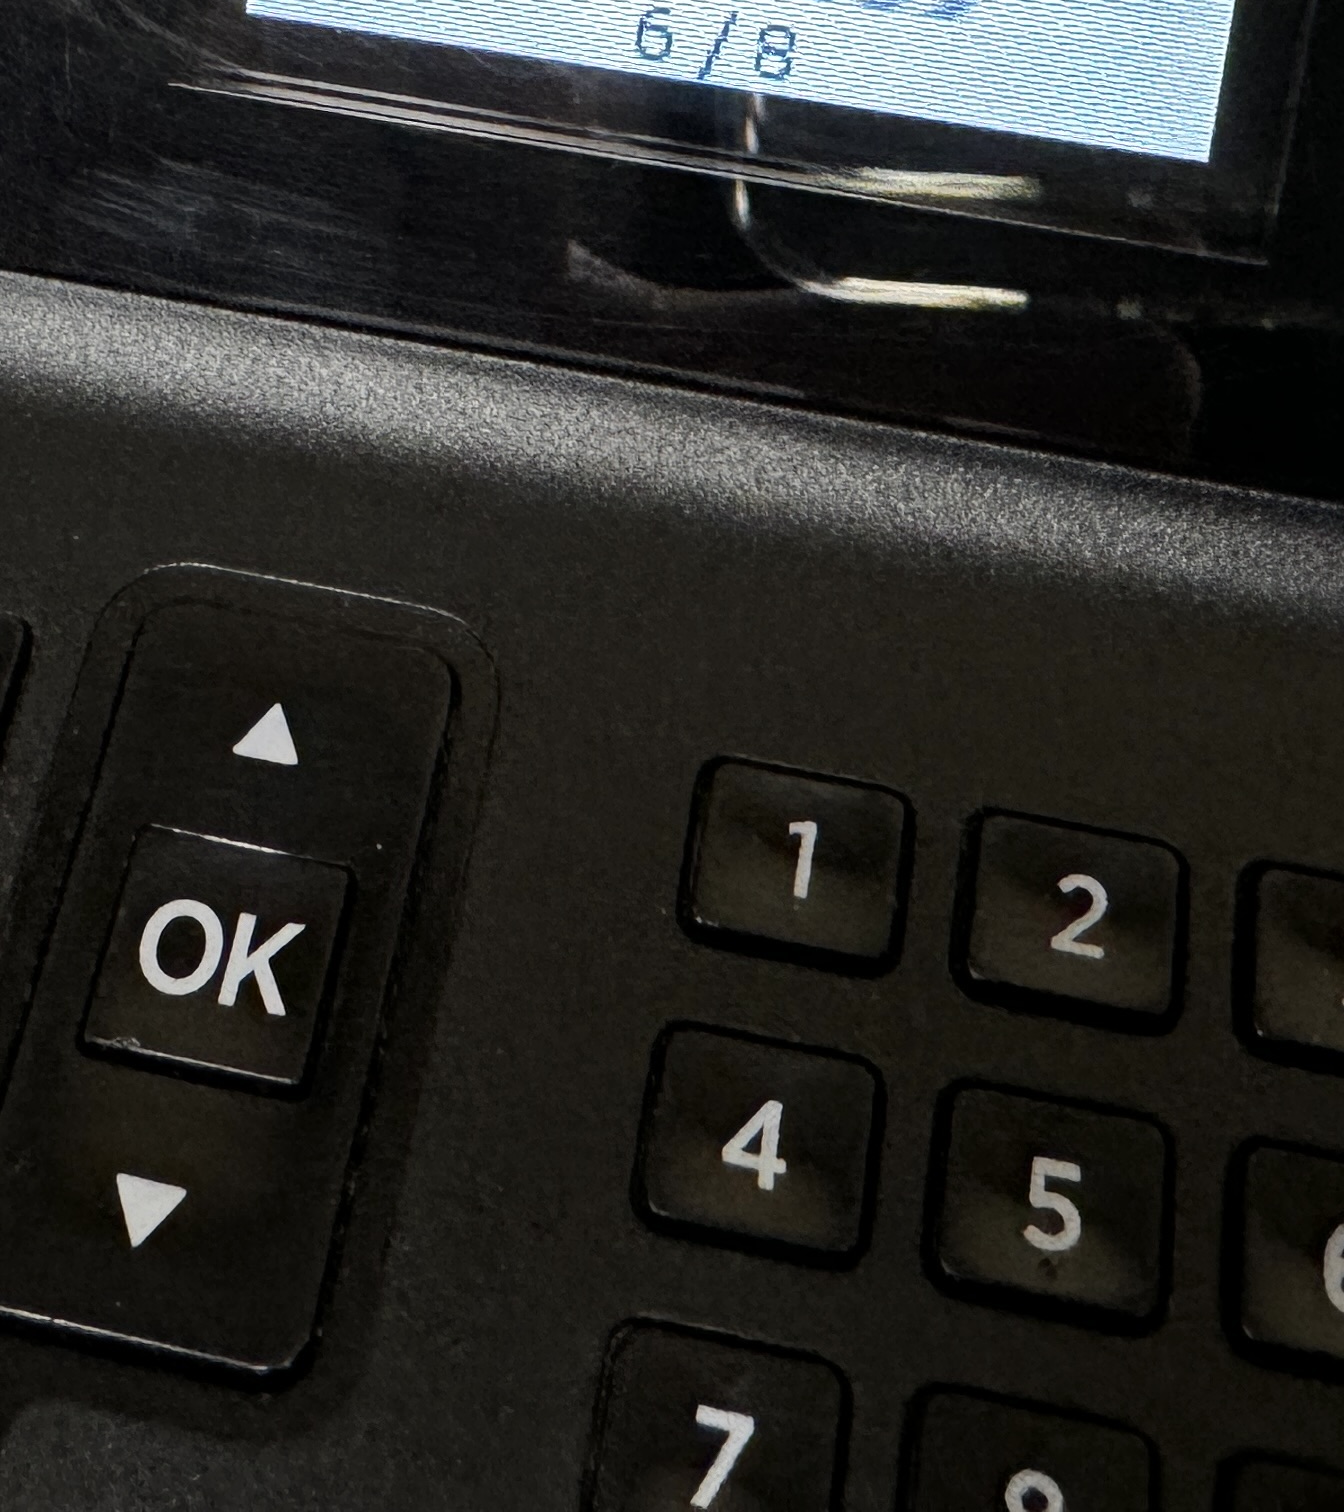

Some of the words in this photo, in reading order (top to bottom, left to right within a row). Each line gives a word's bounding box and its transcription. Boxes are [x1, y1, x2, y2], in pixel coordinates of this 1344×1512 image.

[788, 820, 818, 900] 1
[138, 898, 306, 1017] OK
[1050, 873, 1109, 960] 2
[721, 1099, 787, 1191] 4
[1023, 1156, 1082, 1252] 5
[689, 1403, 756, 1509] 7
